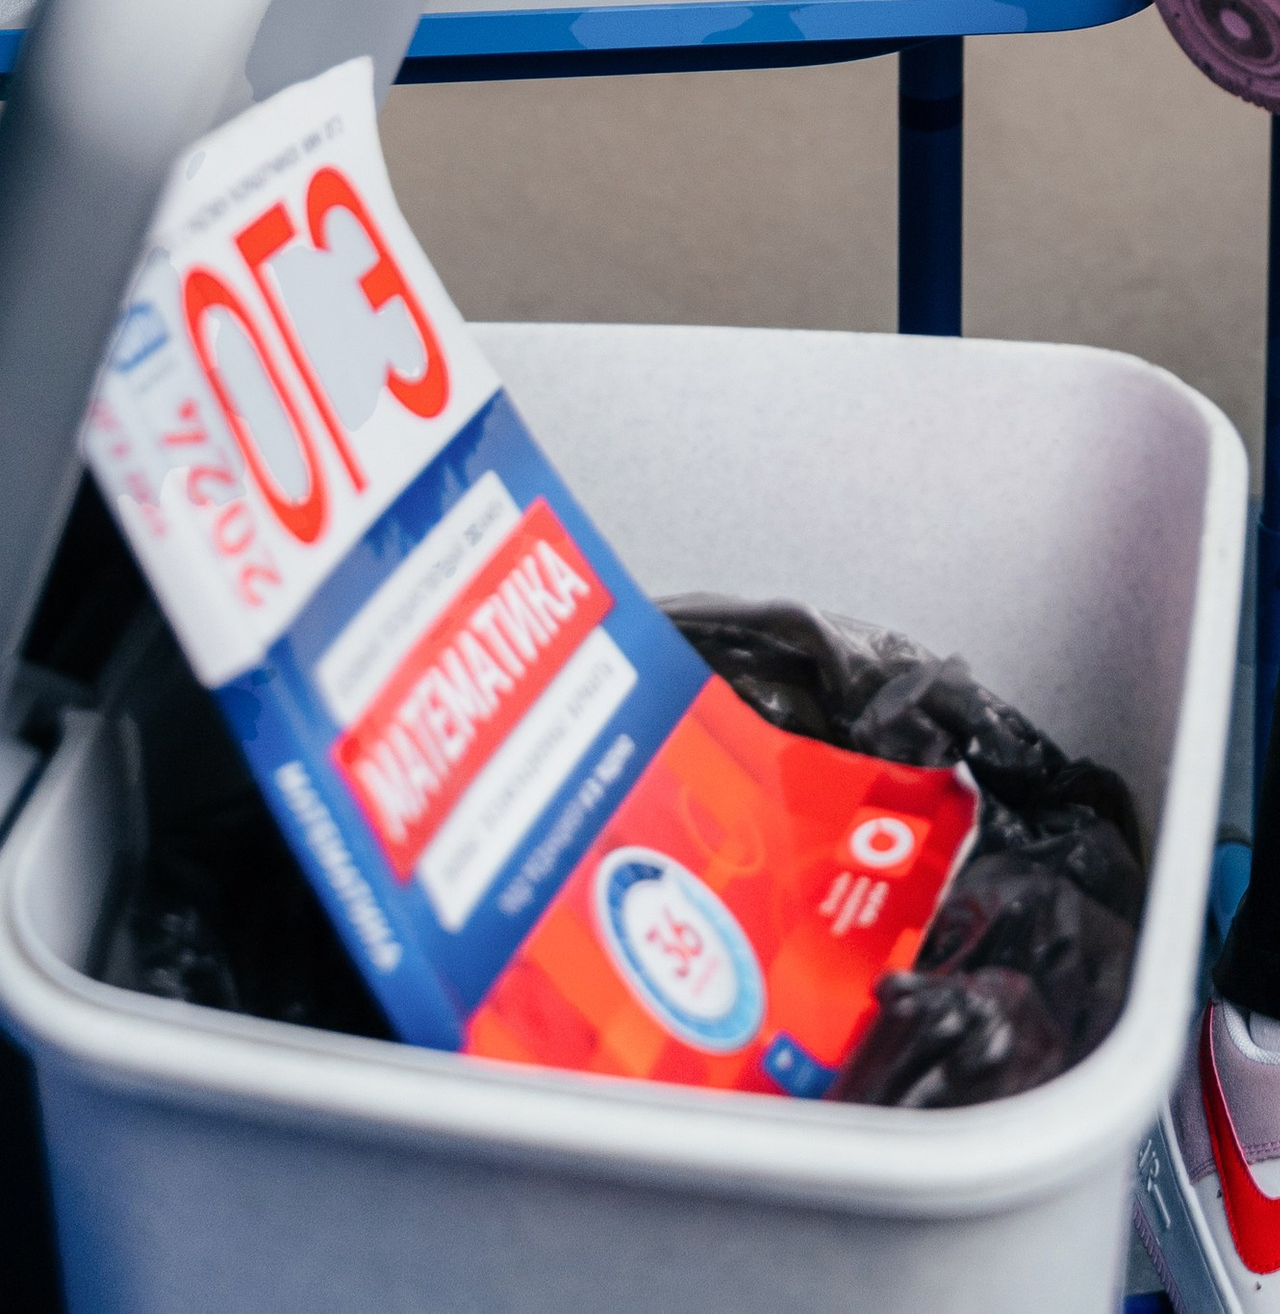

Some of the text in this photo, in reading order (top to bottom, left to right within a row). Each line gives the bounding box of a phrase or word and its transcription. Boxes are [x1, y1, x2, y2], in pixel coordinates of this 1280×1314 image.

[183, 166, 451, 545] ОГЭ
[158, 395, 283, 609] 2024
[356, 535, 591, 844] МАТЕМАТИКА
[644, 905, 703, 979] 36
